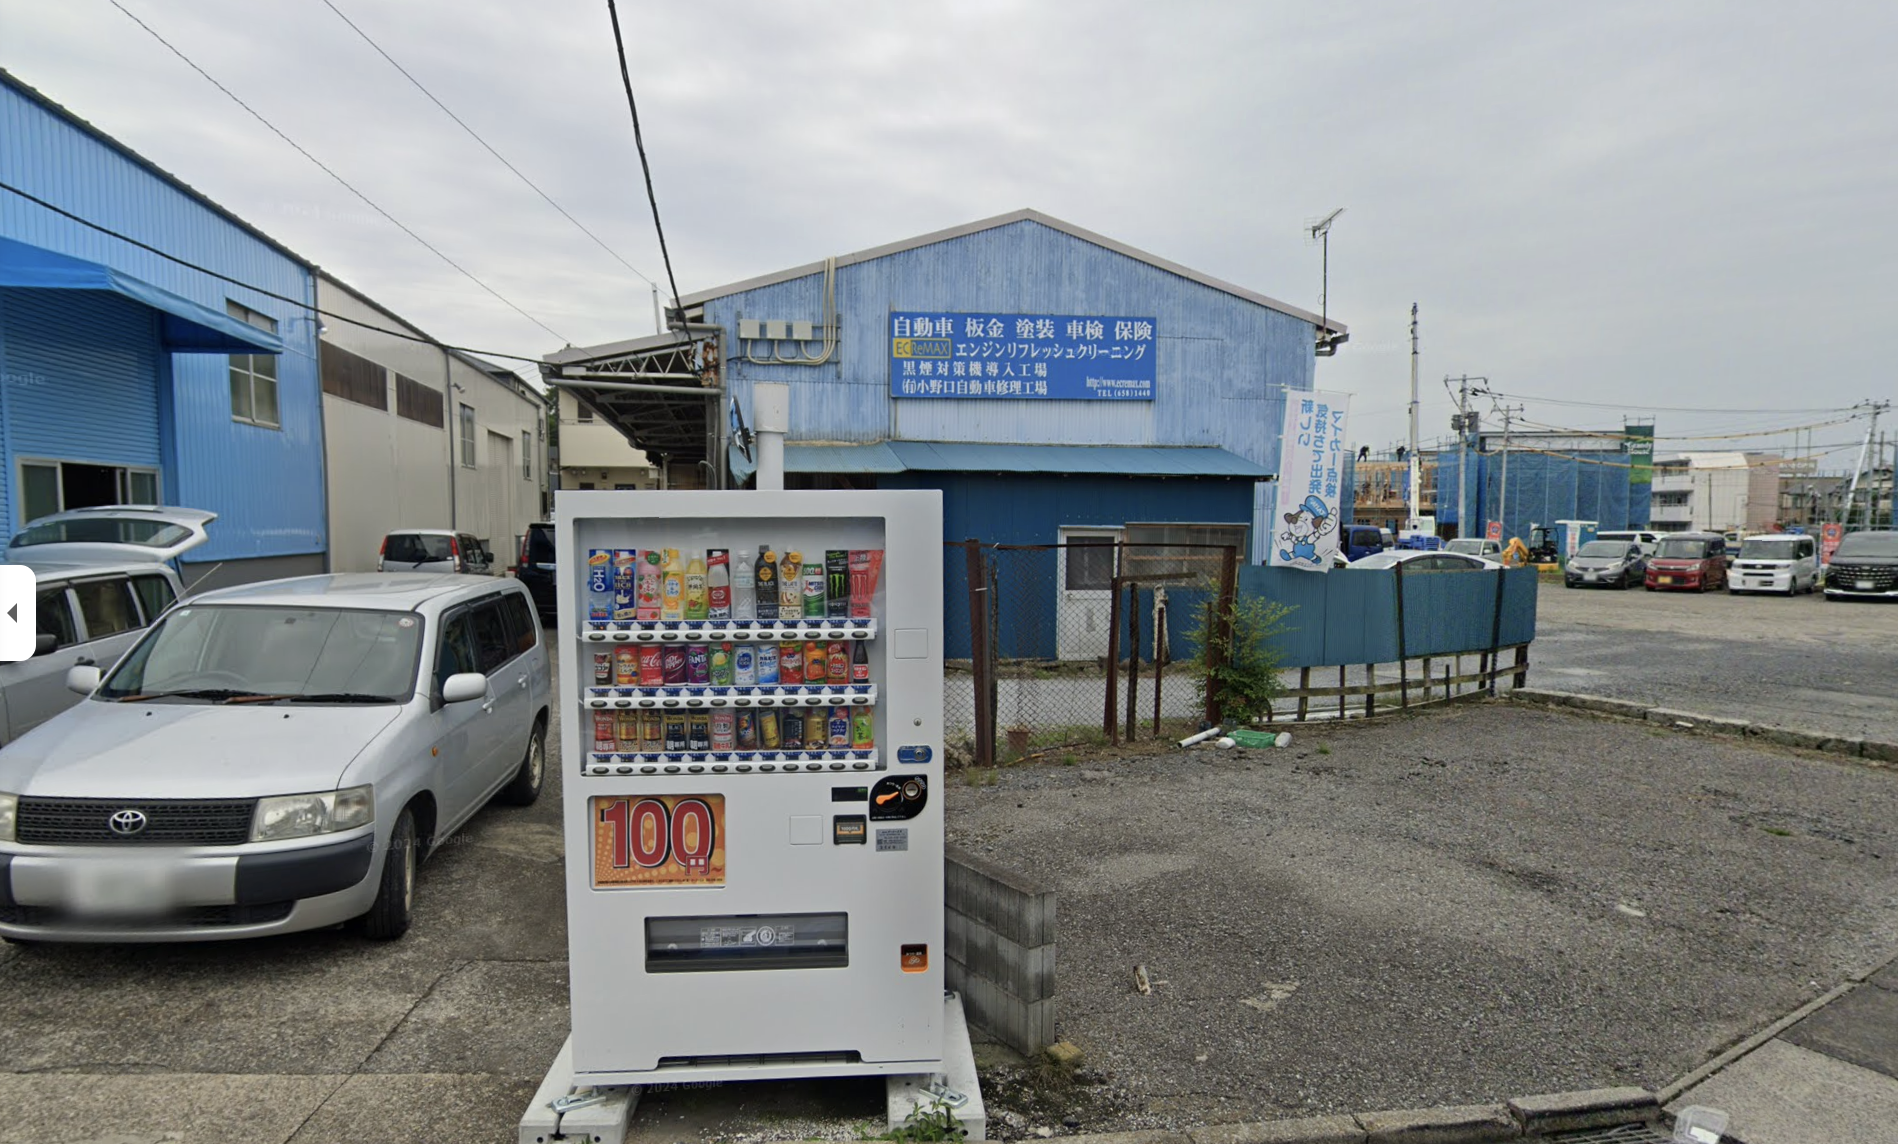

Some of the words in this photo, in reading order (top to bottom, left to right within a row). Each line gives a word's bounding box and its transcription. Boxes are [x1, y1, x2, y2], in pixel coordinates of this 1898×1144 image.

[894, 316, 954, 337] 自動車
[965, 317, 1004, 338] 板金
[1016, 318, 1054, 339] 塗装
[1066, 320, 1104, 340] 車検
[1114, 321, 1153, 341] 保険
[956, 341, 1147, 360] エンジンリフレッシュクリーニング
[903, 361, 1048, 377] 黒煙対策機導入工場
[1097, 389, 1112, 397] TEL
